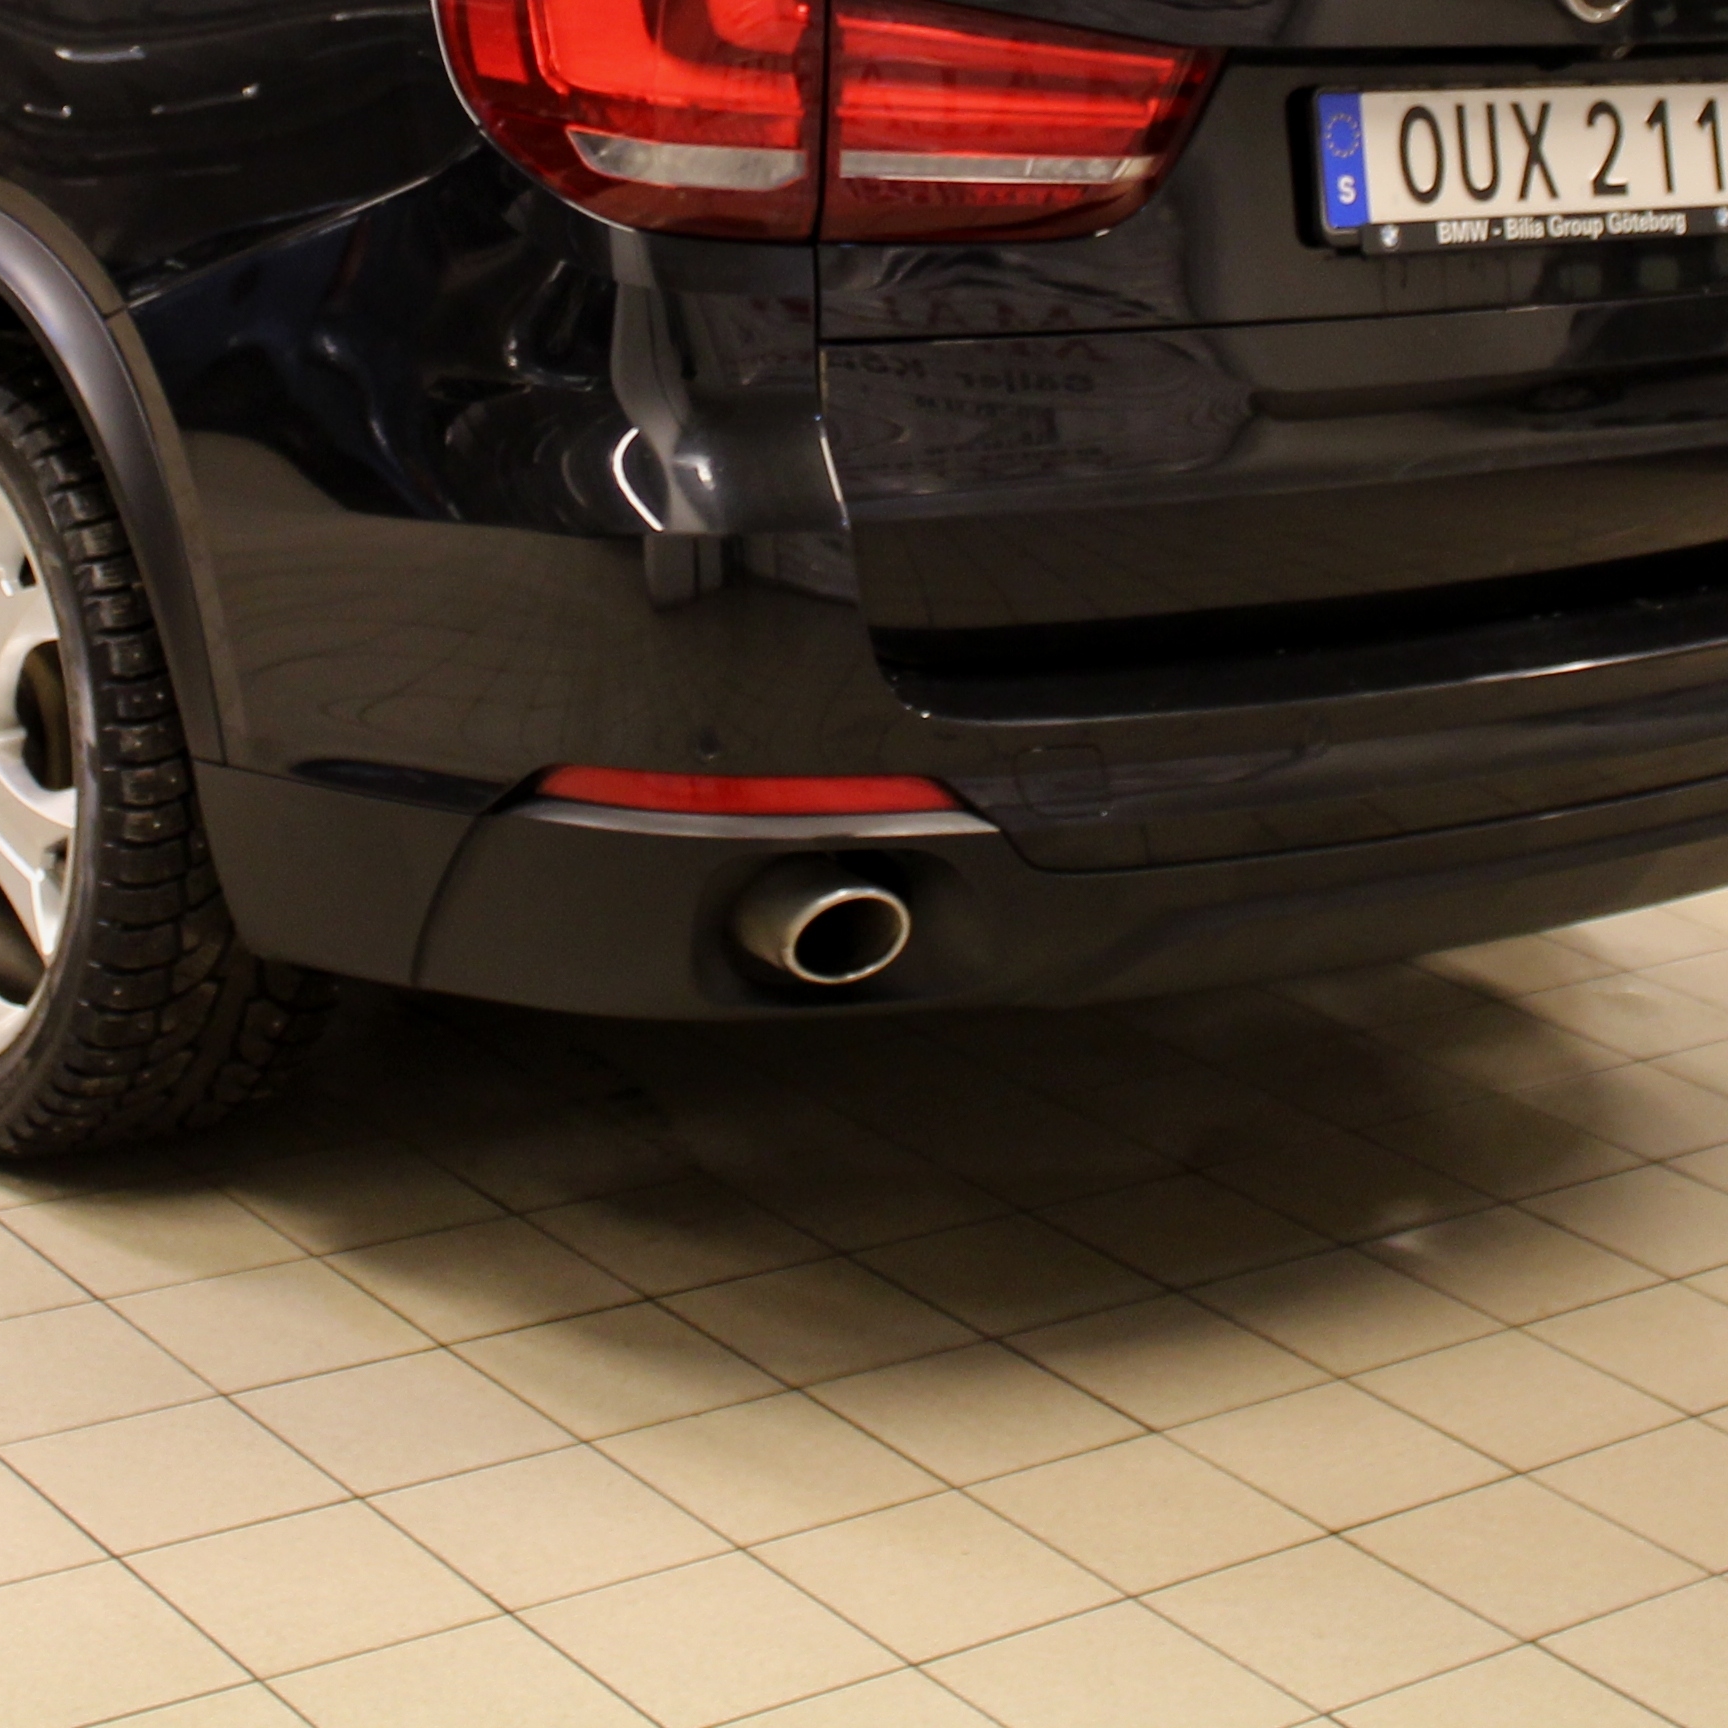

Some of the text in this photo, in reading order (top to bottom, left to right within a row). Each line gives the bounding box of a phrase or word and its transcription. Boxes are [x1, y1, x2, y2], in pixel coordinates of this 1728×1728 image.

[1398, 96, 1725, 205] OUX 211
[1336, 174, 1357, 205] S
[1436, 218, 1489, 245] BMW
[1504, 215, 1545, 241] Bilia
[1547, 214, 1605, 240] Group
[1606, 211, 1687, 236] Göteborg
